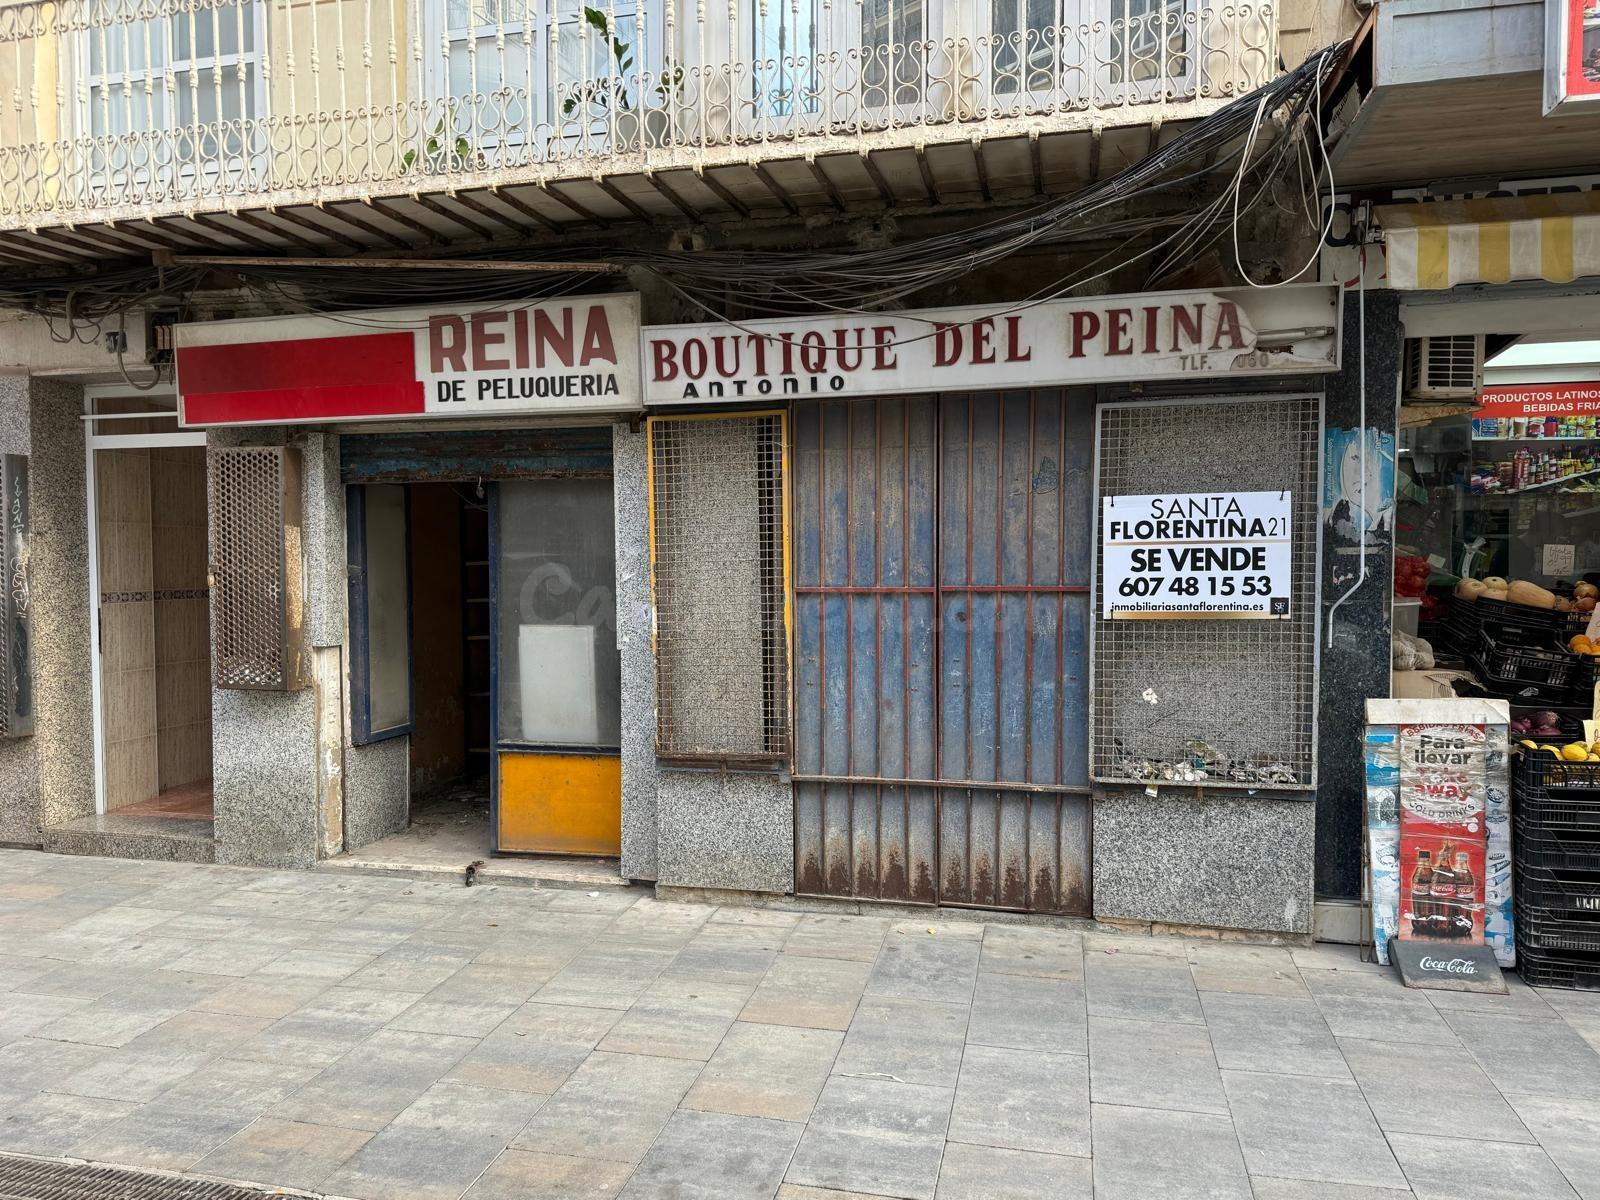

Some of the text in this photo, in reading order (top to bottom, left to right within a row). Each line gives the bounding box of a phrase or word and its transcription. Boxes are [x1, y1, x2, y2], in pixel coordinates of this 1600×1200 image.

[429, 304, 617, 374] REINA
[650, 302, 1249, 383] BOUTIQUE DEL PEINA
[1179, 354, 1212, 371] TLF.
[437, 373, 619, 402] DE PELUQUERIA
[1482, 391, 1553, 404] PRODUCTOS
[1523, 403, 1574, 413] BEBIDAS
[1150, 496, 1244, 520] SANTA
[1110, 517, 1267, 540] FLORENTINA
[1130, 547, 1266, 573] SE VENDE
[1118, 576, 1272, 597] 607 48 15 53
[1111, 602, 1264, 612] inmobiliariasantaflorentina.es
[1420, 735, 1465, 749] Para
[1415, 750, 1472, 764] llevar
